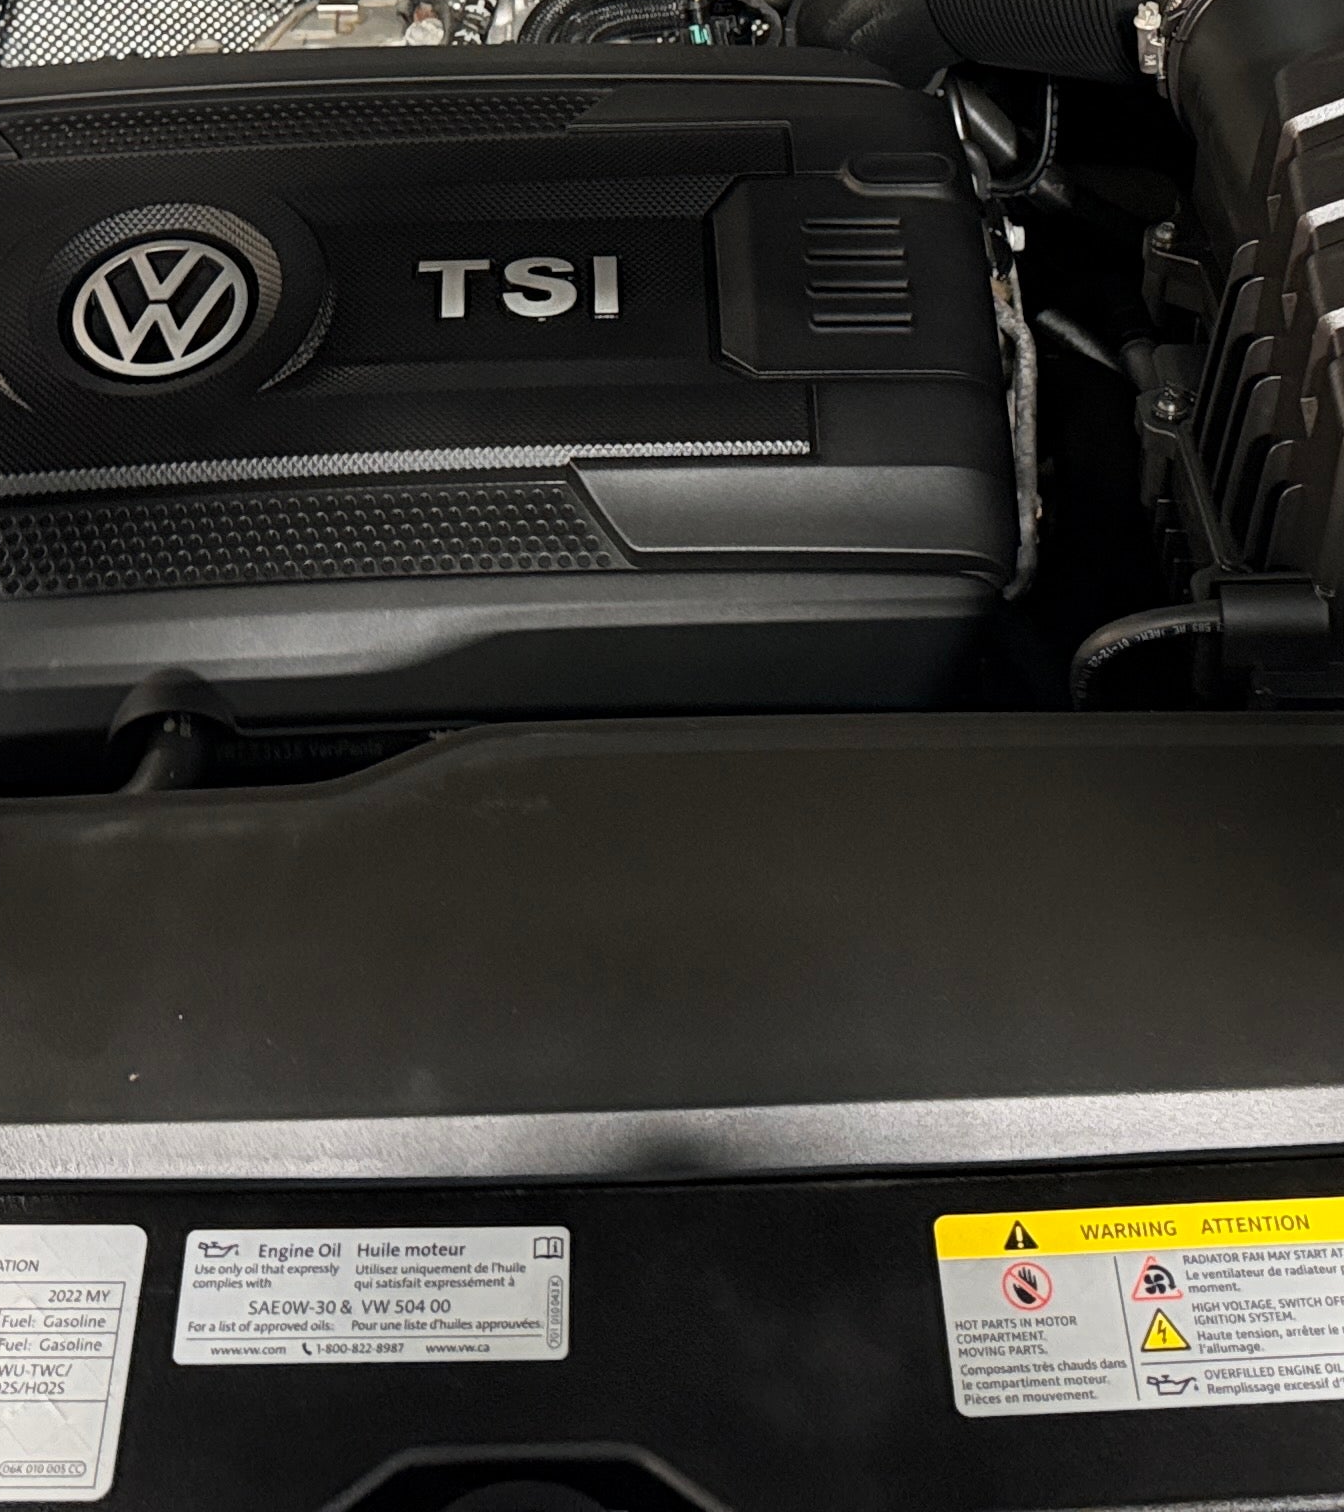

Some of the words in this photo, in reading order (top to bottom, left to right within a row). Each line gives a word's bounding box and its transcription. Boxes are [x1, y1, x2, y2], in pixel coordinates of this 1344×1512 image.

[418, 255, 619, 320] TSI
[1079, 1220, 1177, 1240] WARNING
[1201, 1214, 1310, 1234] ATTENTION
[258, 1243, 314, 1259] Engine
[318, 1243, 341, 1257] Oil
[357, 1242, 400, 1257] Huile
[404, 1242, 466, 1257] moteur
[1181, 1252, 1240, 1265] RADIATOR
[1241, 1251, 1265, 1262] FAN
[1266, 1250, 1290, 1261] MAY
[1292, 1248, 1327, 1260] START
[1330, 1247, 1343, 1258] AT
[194, 1263, 216, 1275] Use
[217, 1263, 242, 1276] only
[244, 1263, 258, 1274] oil
[260, 1263, 284, 1274] that
[286, 1262, 339, 1276] expressly
[355, 1263, 398, 1275] Utilisez
[400, 1263, 472, 1275] uniquement
[473, 1262, 488, 1274] de
[490, 1262, 526, 1275] l'huile
[192, 1277, 243, 1290] complies
[245, 1277, 272, 1288] with
[353, 1277, 373, 1290] qui
[375, 1276, 421, 1288] satisfait
[423, 1276, 505, 1290] expressément
[507, 1275, 515, 1287] à
[47, 1289, 82, 1302] 2022
[85, 1289, 110, 1302] MY
[339, 1299, 352, 1314] &
[361, 1298, 390, 1314] VW
[393, 1299, 425, 1314] 504
[429, 1298, 451, 1313] 00
[1191, 1301, 1220, 1312] HIGH
[1221, 1298, 1276, 1311] VOLTAGE,
[1277, 1296, 1322, 1309] SWITCH
[1, 1315, 35, 1328] Fuel:
[43, 1315, 106, 1328] Gasoline
[954, 1319, 978, 1331] HOT
[980, 1317, 1017, 1329] PARTS
[1019, 1317, 1032, 1327] IN
[1034, 1315, 1077, 1327] MOTOR
[1193, 1313, 1246, 1326] IGNITION
[187, 1321, 206, 1332] For
[208, 1323, 216, 1332] a
[218, 1320, 236, 1332] list
[238, 1320, 252, 1332] of
[253, 1320, 308, 1334] approved
[39, 1339, 102, 1351] Gasoline
[210, 1346, 286, 1355] www.vw.com
[425, 1343, 490, 1353] www.vw.ca
[957, 1345, 1005, 1358] MOVING
[1203, 1366, 1275, 1380] OVERFILLED
[1277, 1364, 1322, 1376] ENGINE
[1324, 1363, 1344, 1374] OIL
